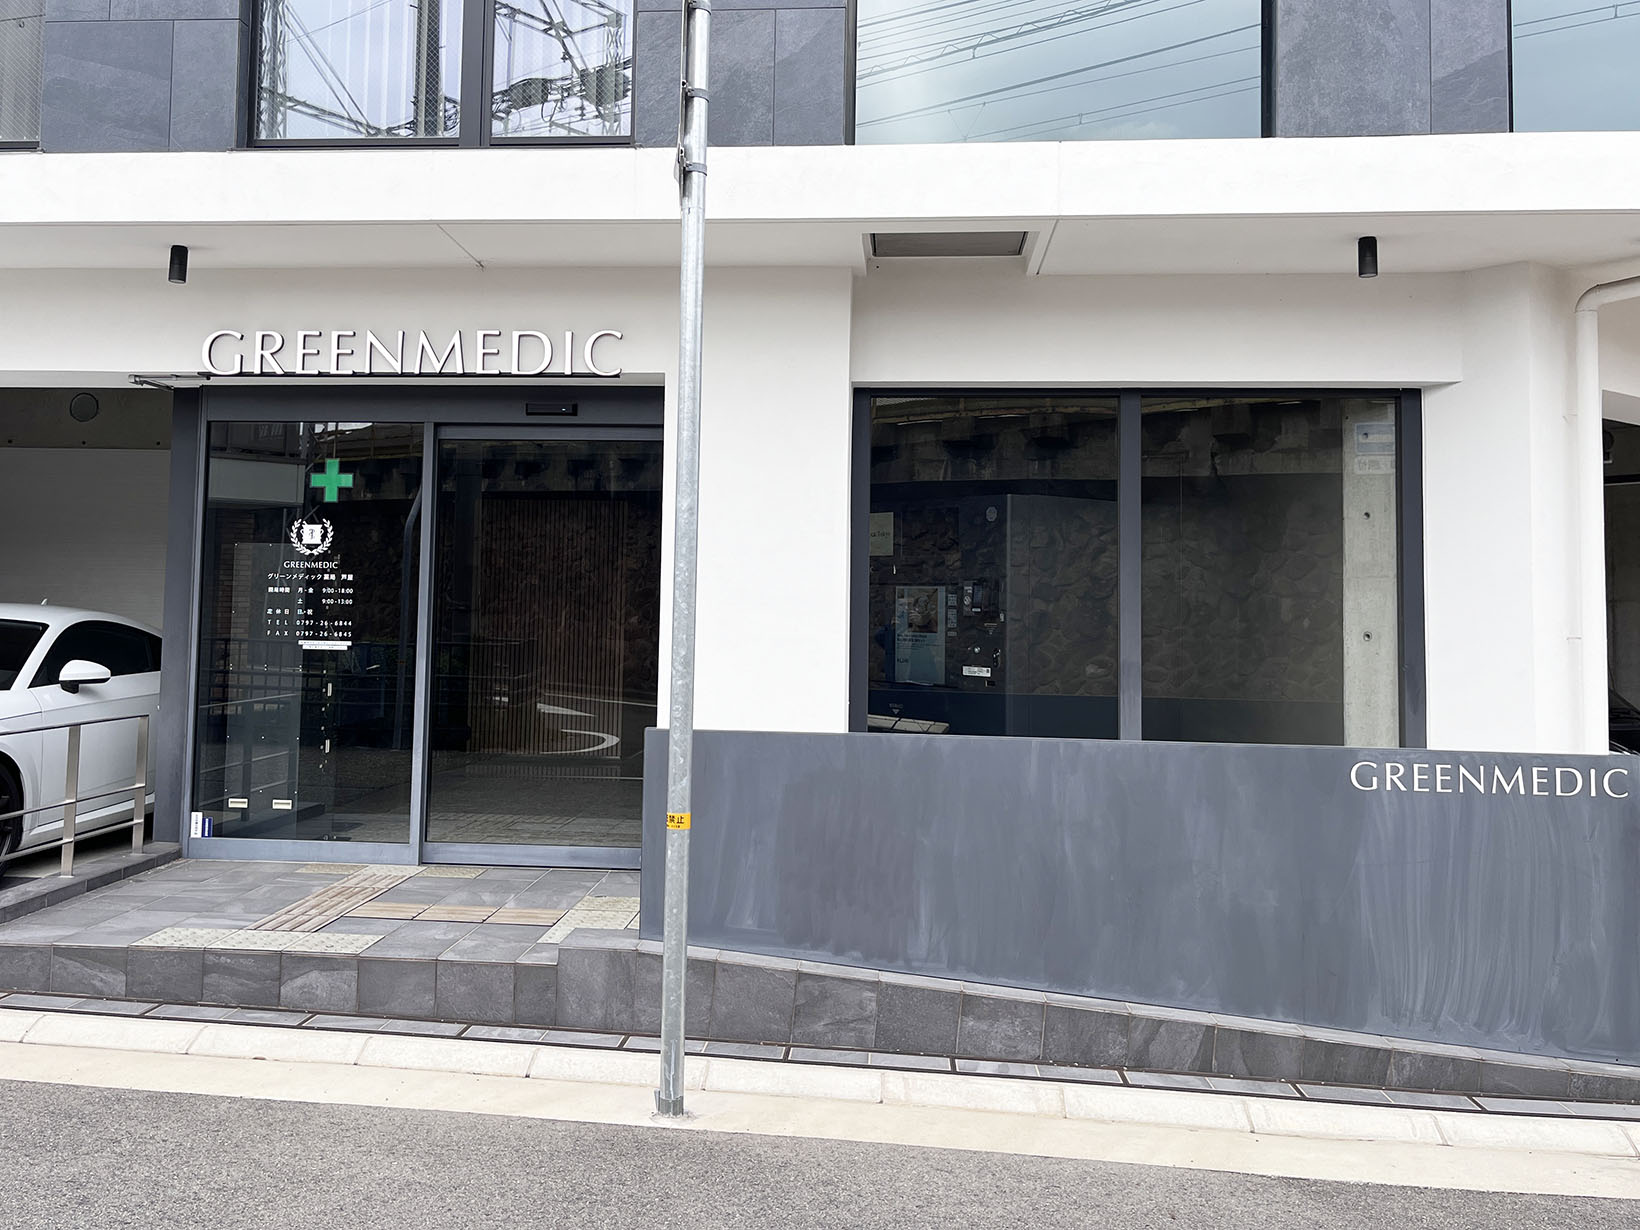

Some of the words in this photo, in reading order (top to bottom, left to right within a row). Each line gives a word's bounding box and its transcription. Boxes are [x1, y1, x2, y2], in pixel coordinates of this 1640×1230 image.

[201, 329, 624, 377] GREENMEDIC
[283, 561, 339, 569] GREENMEDIC
[1349, 761, 1630, 799] GREENMEDIC
